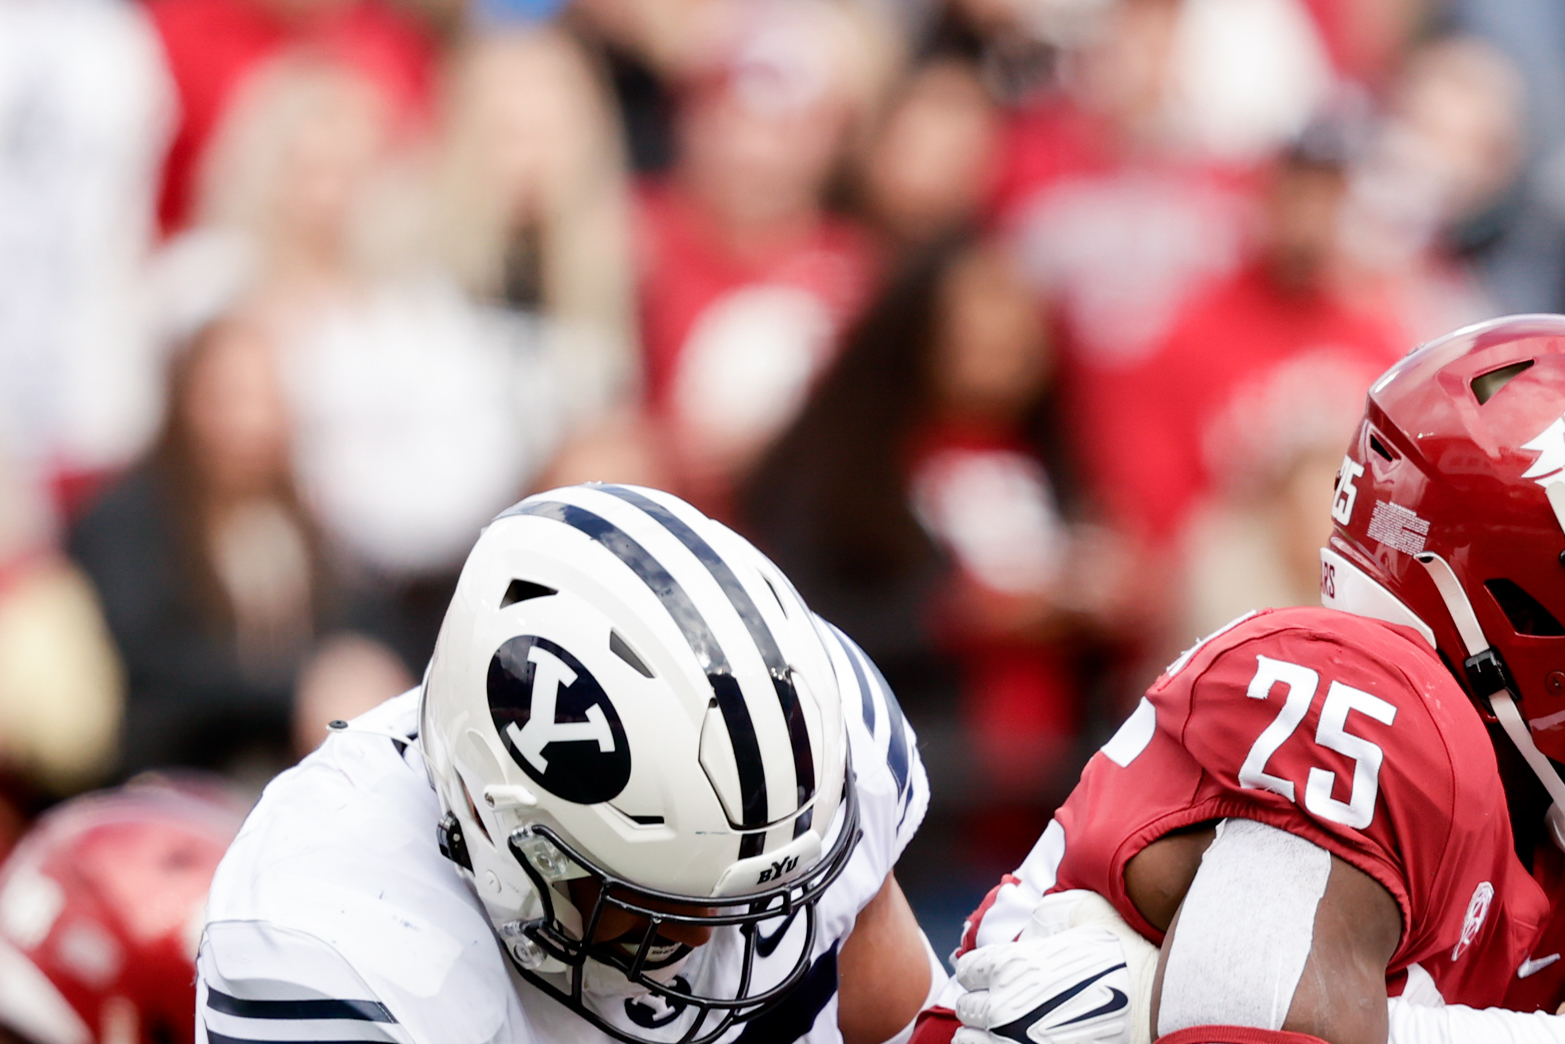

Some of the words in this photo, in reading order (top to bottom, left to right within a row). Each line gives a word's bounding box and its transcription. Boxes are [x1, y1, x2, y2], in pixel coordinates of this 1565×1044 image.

[505, 645, 616, 775] Y
[1238, 653, 1398, 830] 25
[756, 855, 800, 886] BYU
